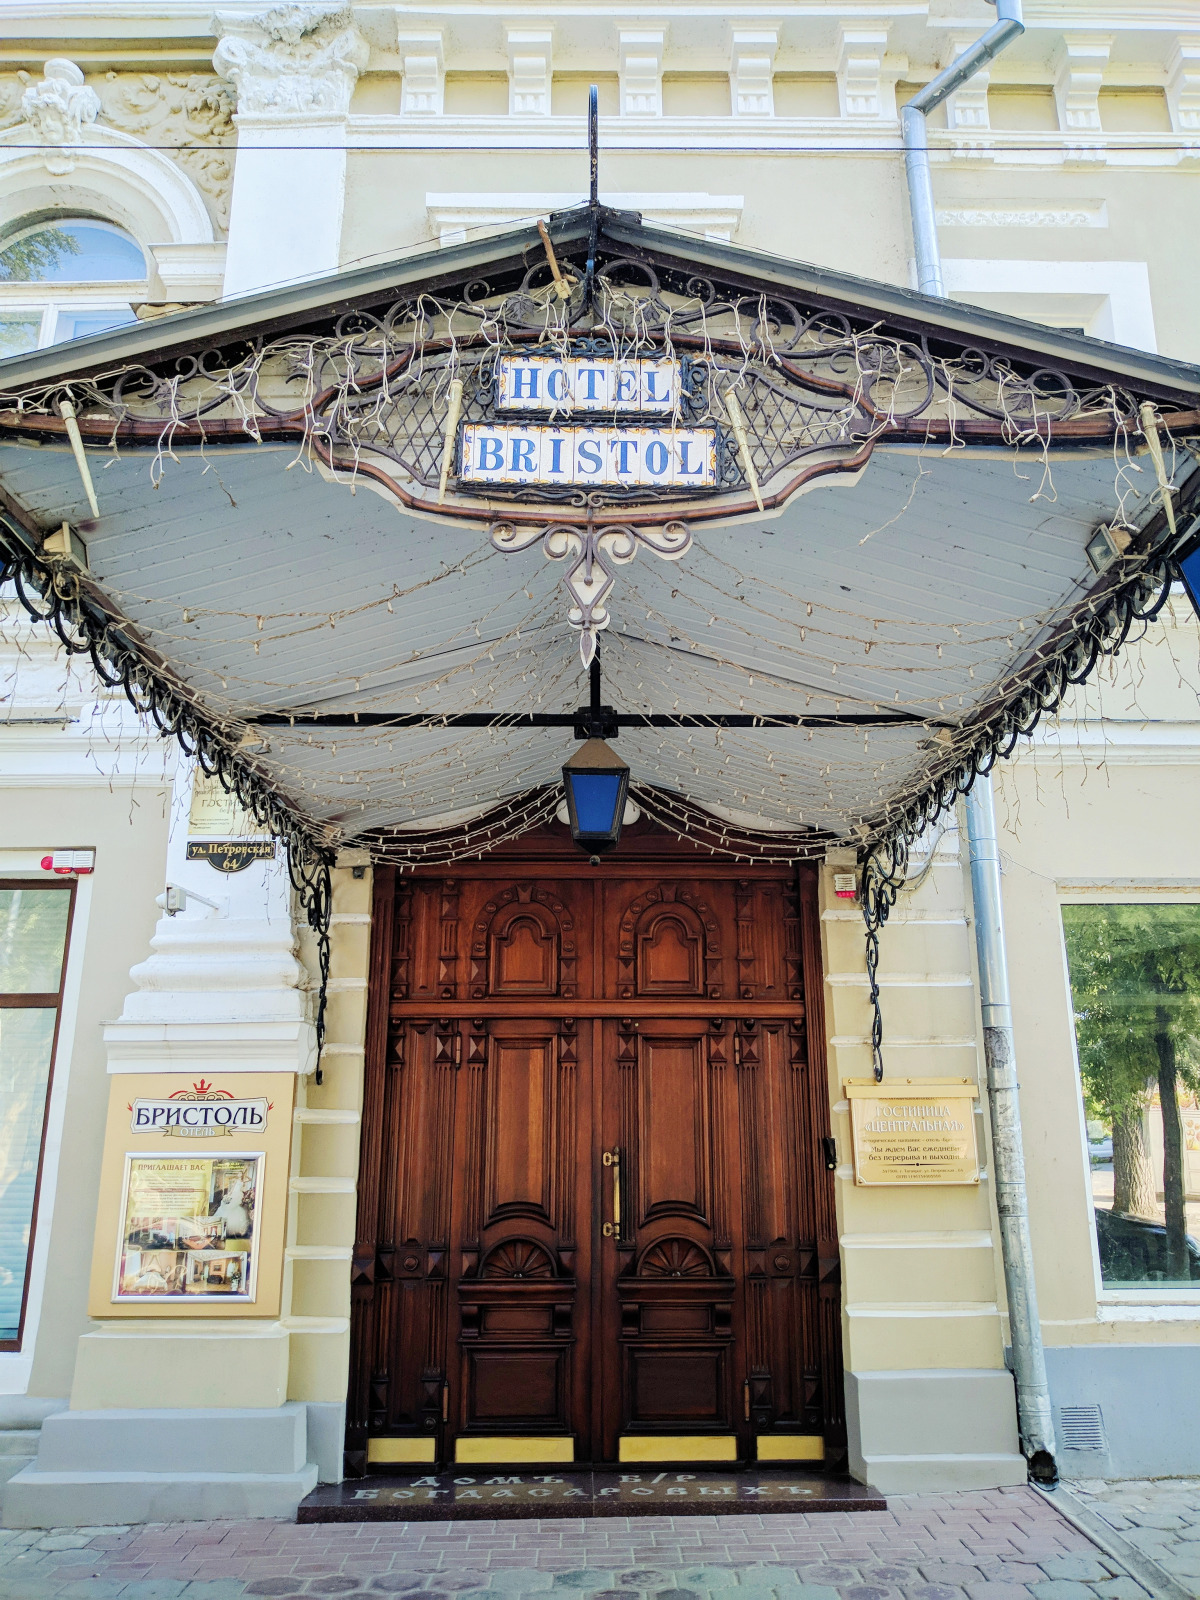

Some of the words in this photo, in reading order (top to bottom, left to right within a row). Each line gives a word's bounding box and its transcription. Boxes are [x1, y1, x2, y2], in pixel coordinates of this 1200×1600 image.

[511, 367, 670, 403] HOTEL
[475, 436, 703, 475] BRISTOL
[191, 846, 206, 857] ул.
[208, 843, 271, 856] Петровская
[222, 859, 237, 869] 64
[135, 1106, 263, 1126] БРИСТОЛЬ
[875, 1105, 951, 1118] ГОСТИНИЦА
[179, 1127, 216, 1137] ОТЕЛЬ
[864, 1119, 965, 1132] «ЦЕНТРАЛЬНАЯ»
